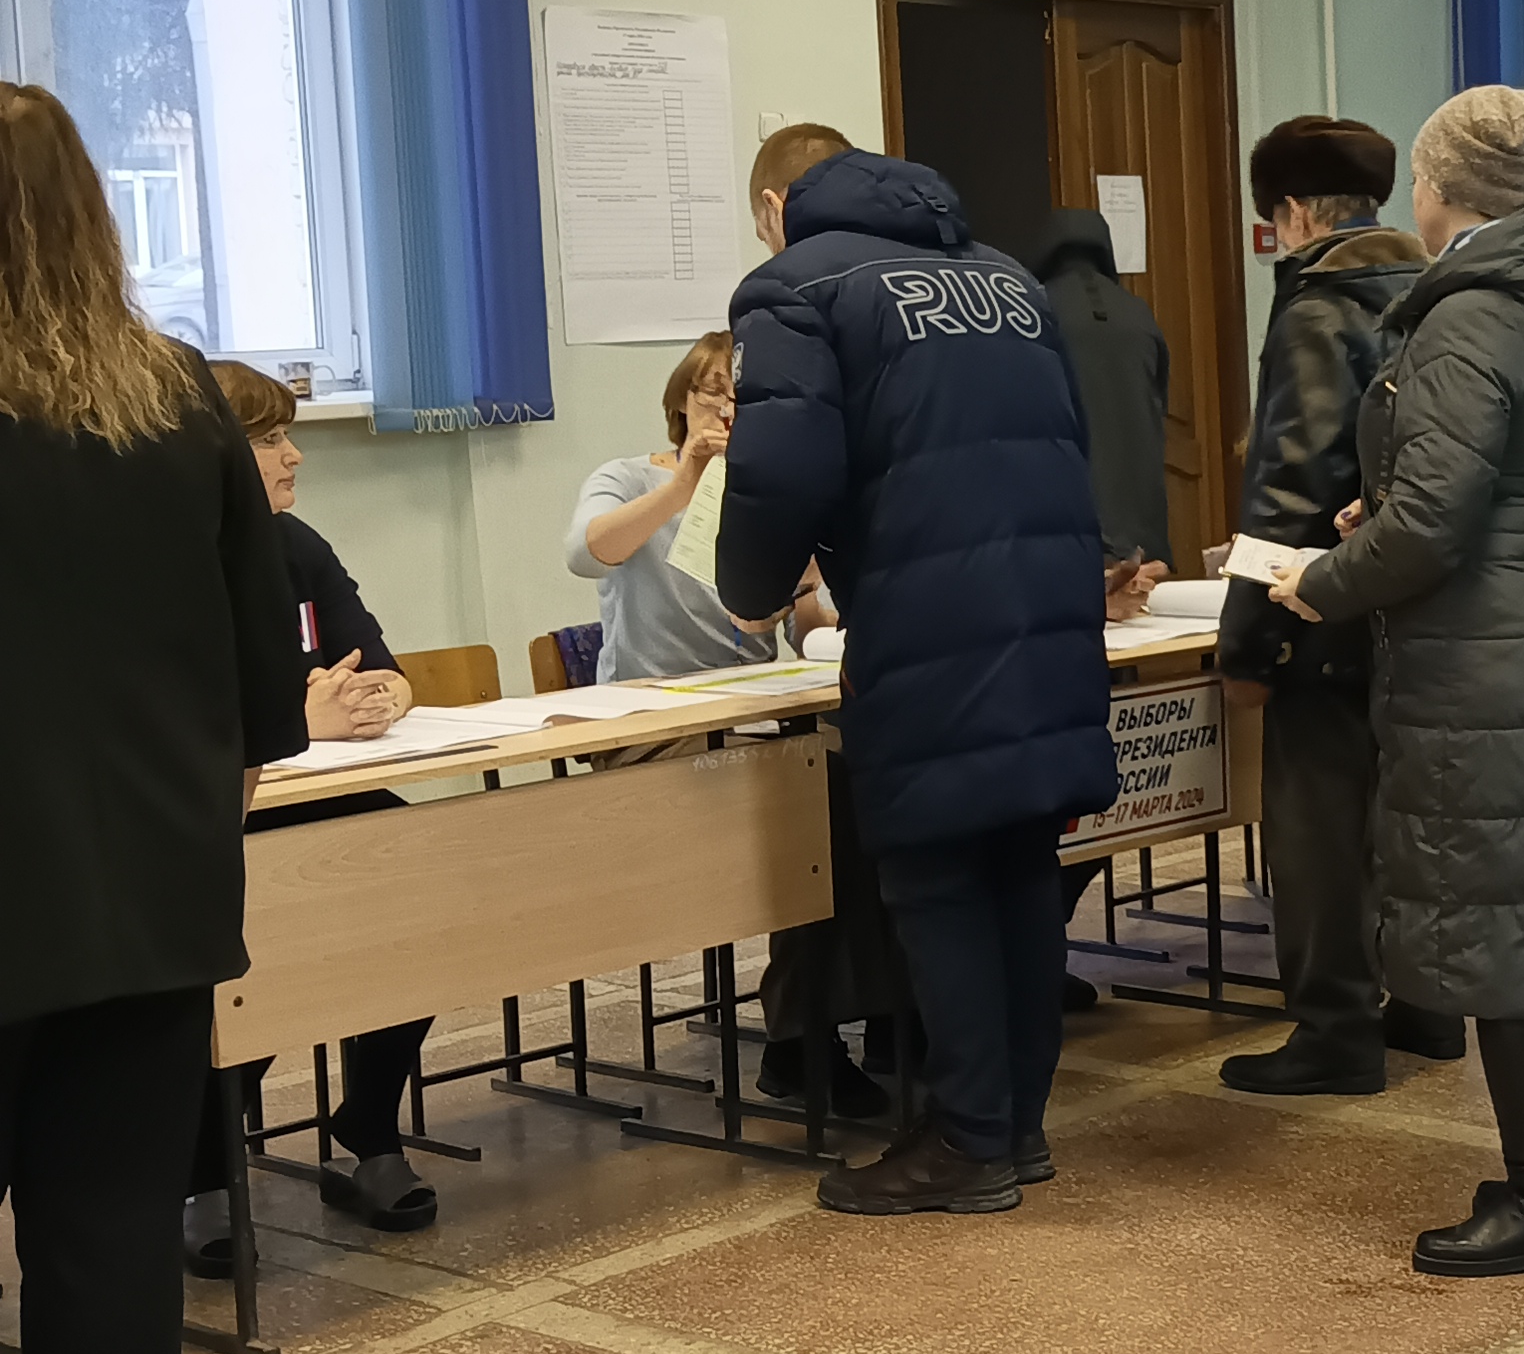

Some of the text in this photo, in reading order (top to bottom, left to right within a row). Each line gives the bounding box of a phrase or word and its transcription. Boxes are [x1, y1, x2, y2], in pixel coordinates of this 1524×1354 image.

[881, 269, 1042, 341] RUS
[1115, 697, 1195, 732] ВЫБОРЫ
[1129, 793, 1173, 821] МАРТА
[1174, 786, 1204, 812] 2024
